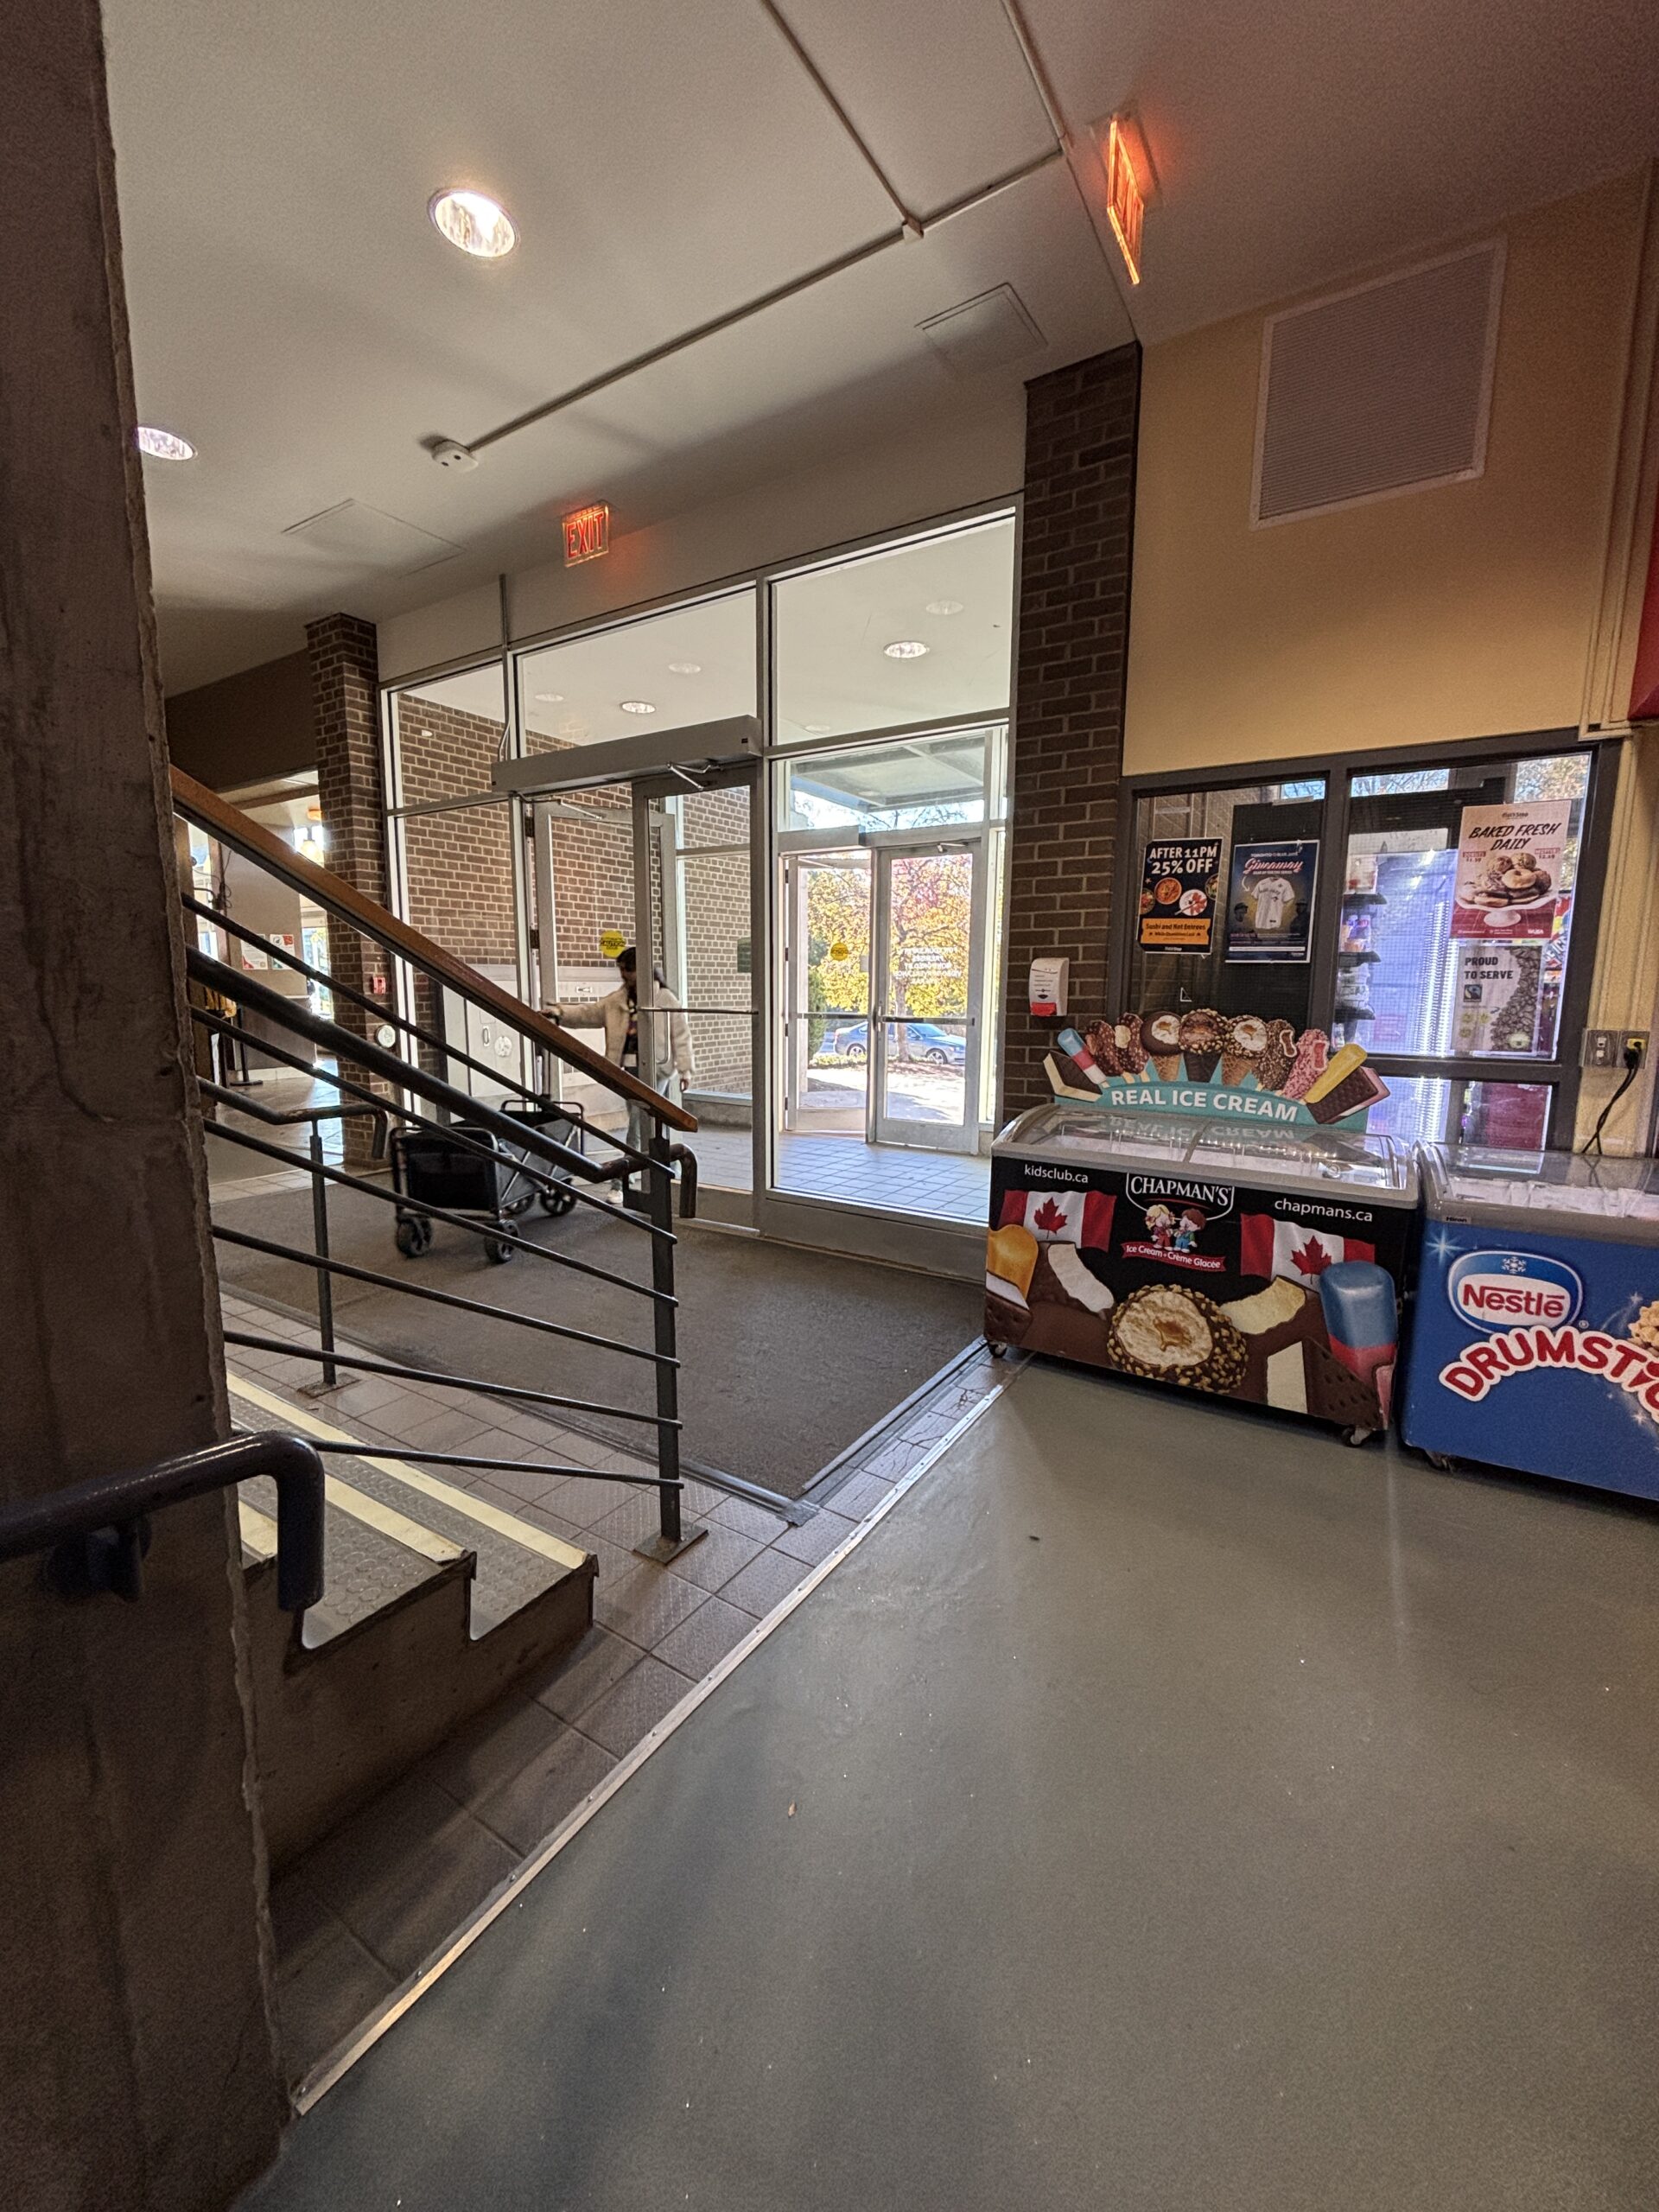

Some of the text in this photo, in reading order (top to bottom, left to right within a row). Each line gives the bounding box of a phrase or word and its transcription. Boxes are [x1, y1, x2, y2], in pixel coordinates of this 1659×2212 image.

[566, 511, 605, 559] EXIT
[1469, 823, 1562, 838] BAKED FRESH
[1149, 846, 1217, 859] AFTER 11PM
[1491, 838, 1531, 851] DAILY
[1151, 858, 1213, 876] 25% OFF
[1243, 857, 1304, 874] Giveaway
[1465, 957, 1498, 966] PROUD
[1464, 970, 1514, 979] TO SERVE
[1111, 1089, 1298, 1122] REAL ICE CREAM
[1024, 1164, 1089, 1184] kidsclub.ca
[1130, 1176, 1229, 1206] CHAPMAN'S
[1274, 1198, 1373, 1222] chapmans.ca
[1138, 1245, 1163, 1257] Cream
[1167, 1251, 1192, 1265] Crème
[1193, 1257, 1221, 1268] Glacée
[1463, 1284, 1566, 1319] Nestlé
